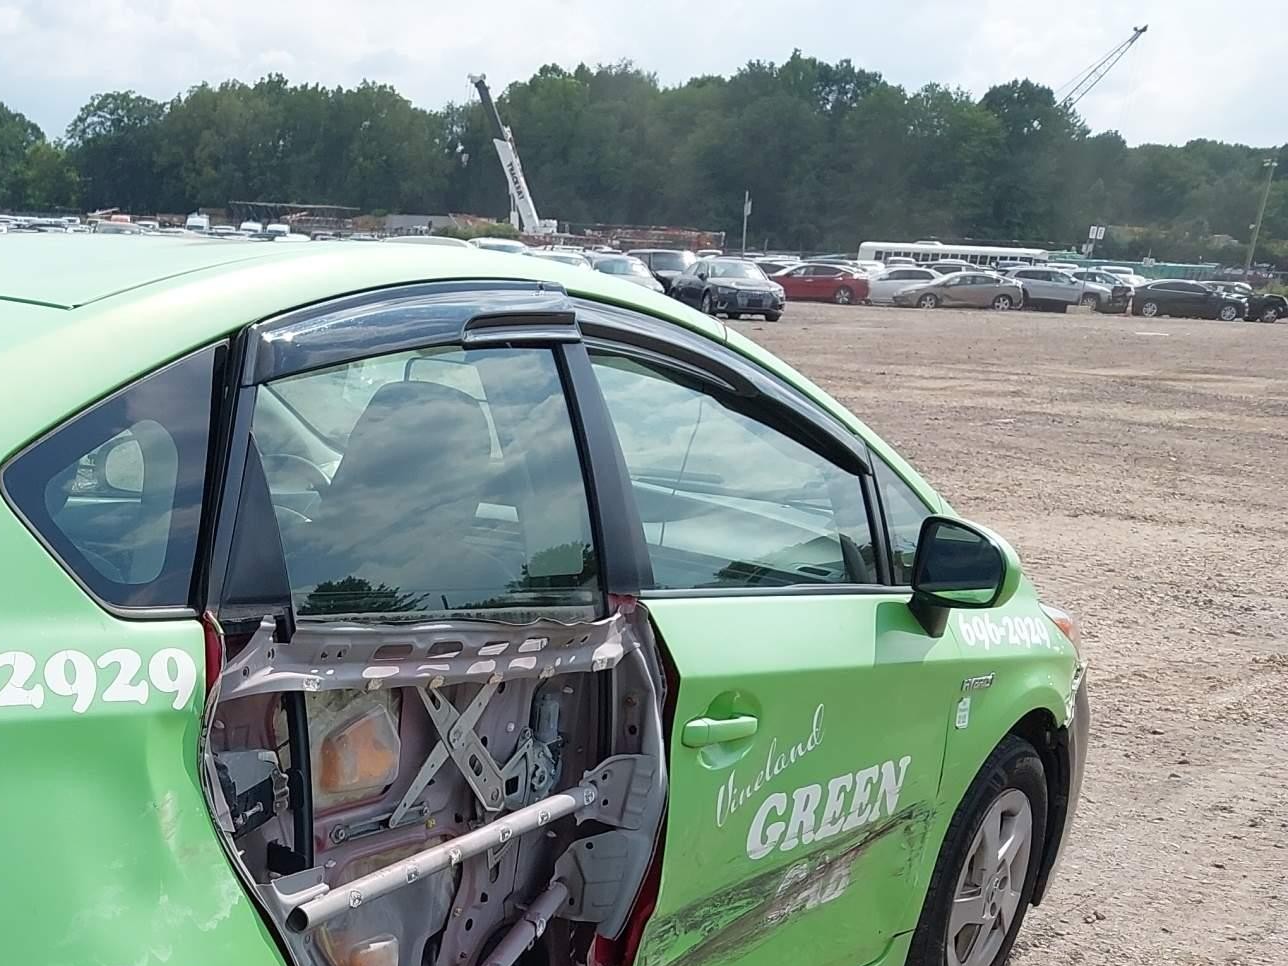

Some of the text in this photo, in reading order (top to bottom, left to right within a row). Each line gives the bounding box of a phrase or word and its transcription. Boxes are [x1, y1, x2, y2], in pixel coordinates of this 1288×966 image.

[958, 612, 1051, 650] 696-2929
[716, 703, 825, 828] Vineland
[746, 755, 912, 860] GREEN
